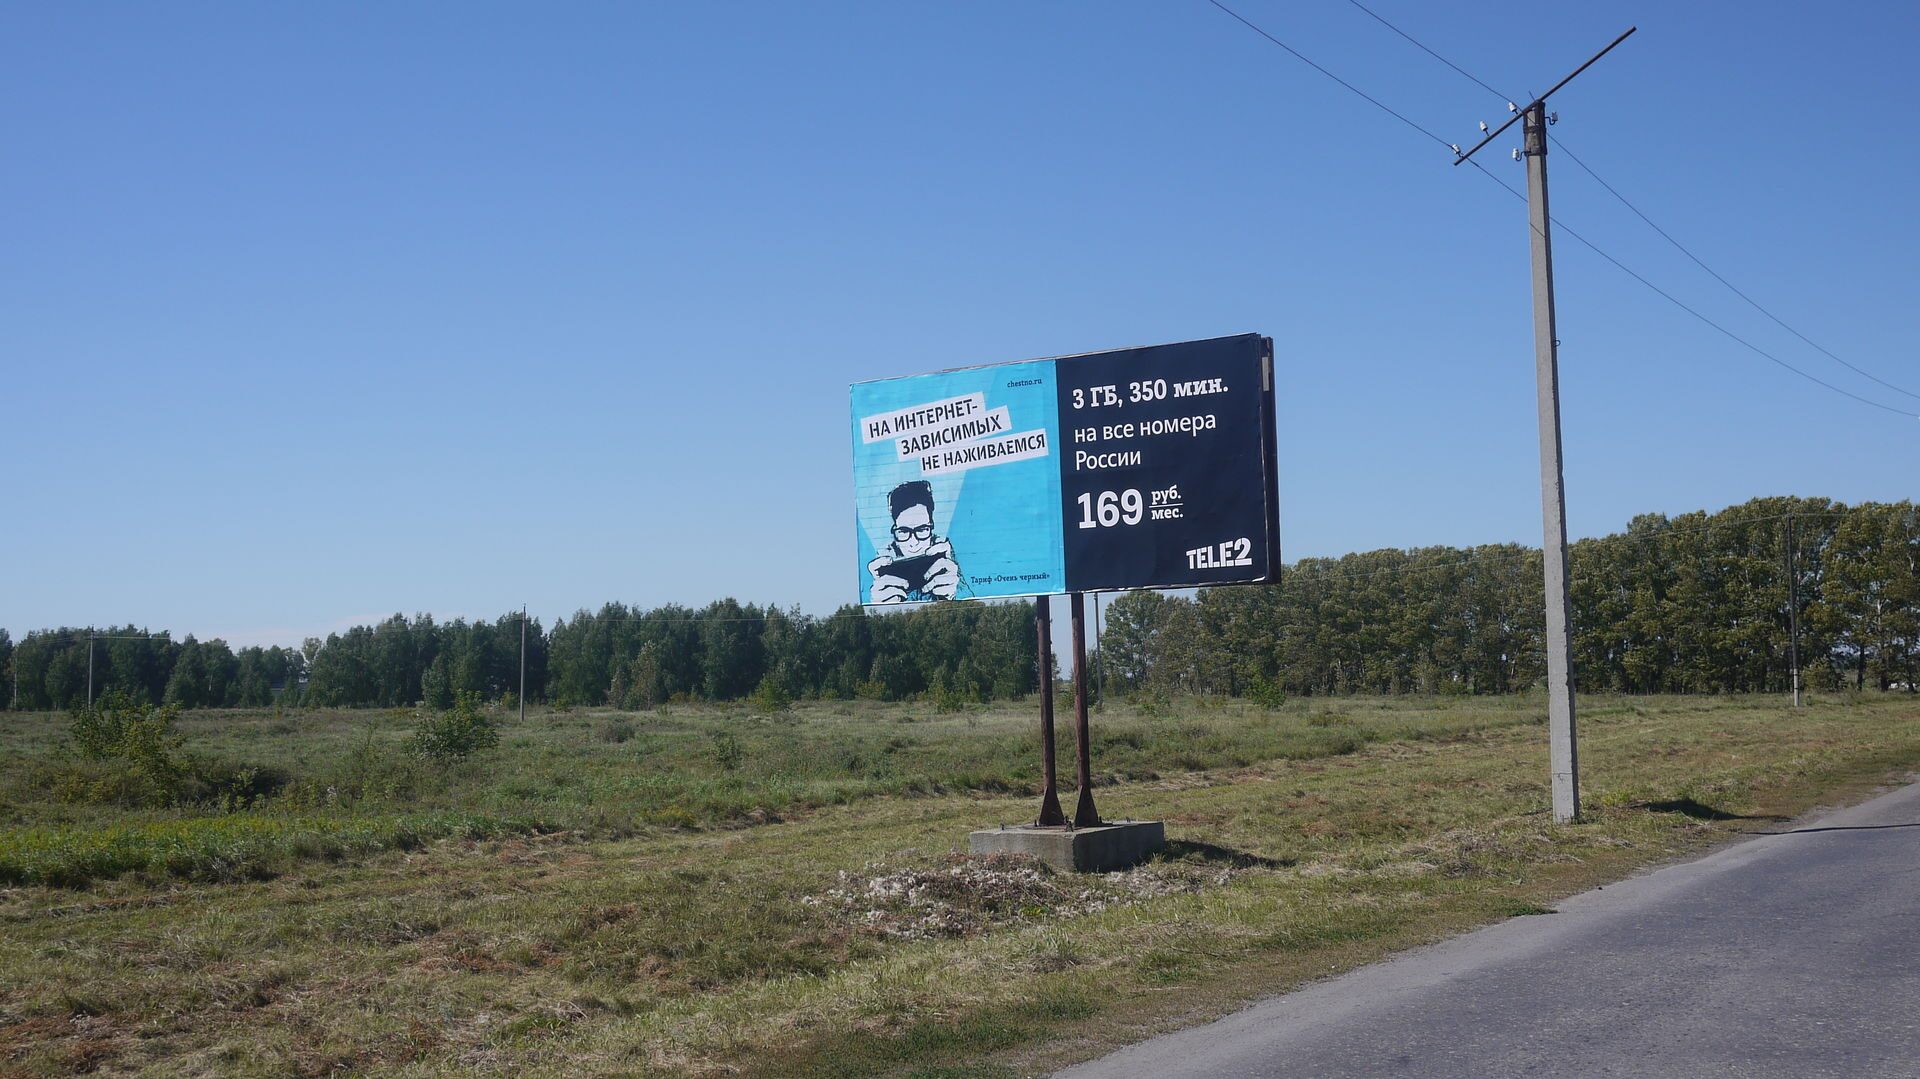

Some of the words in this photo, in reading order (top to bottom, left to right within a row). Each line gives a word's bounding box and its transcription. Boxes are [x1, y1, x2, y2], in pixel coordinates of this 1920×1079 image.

[1007, 378, 1042, 388] chestno.ru
[1072, 389, 1085, 409] 3
[1090, 384, 1123, 408] ГБ,
[1129, 378, 1167, 403] 350
[1173, 377, 1229, 398] мин.
[869, 420, 891, 438] НА
[894, 398, 978, 432] ИНТЕРНЕТ-
[1074, 427, 1097, 443] на
[1103, 423, 1134, 440] все
[1140, 413, 1216, 437] номера
[901, 414, 1002, 455] ЗАВИСИМЫХ
[922, 454, 940, 471] НЕ
[943, 433, 1046, 467] НАЖИВАЕМСЯ
[1075, 450, 1141, 471] России
[1077, 488, 1143, 529] 169
[1151, 484, 1182, 505] руб.
[1151, 507, 1184, 520] мес.
[1186, 537, 1253, 570] TELE2
[970, 576, 993, 584] Тариф
